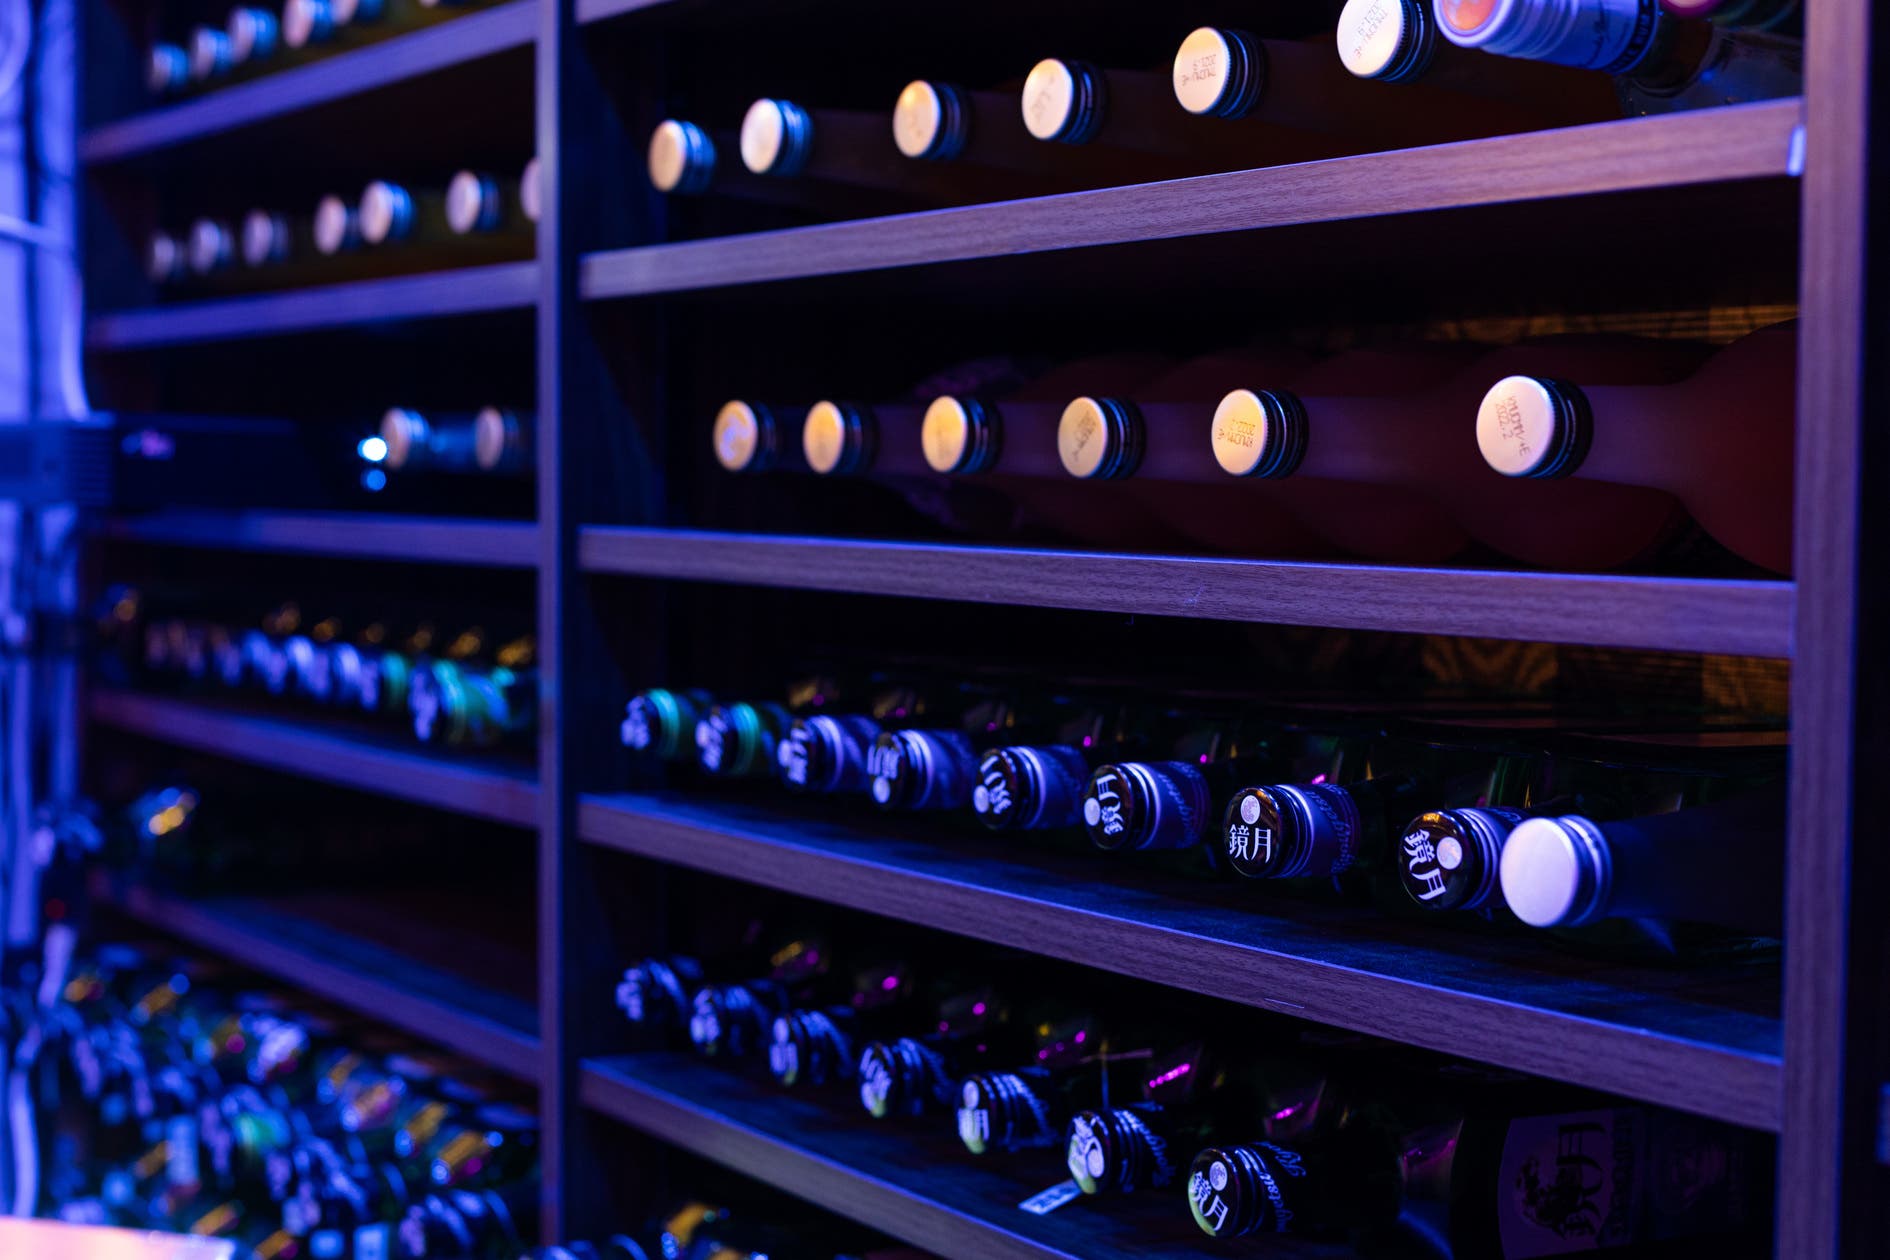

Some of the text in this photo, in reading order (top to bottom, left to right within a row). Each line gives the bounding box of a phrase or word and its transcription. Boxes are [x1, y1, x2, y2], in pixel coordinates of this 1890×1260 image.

[1229, 823, 1272, 863] 鏡月
[1403, 828, 1448, 901] 鏡月
[1190, 1170, 1230, 1232] 鏡月
